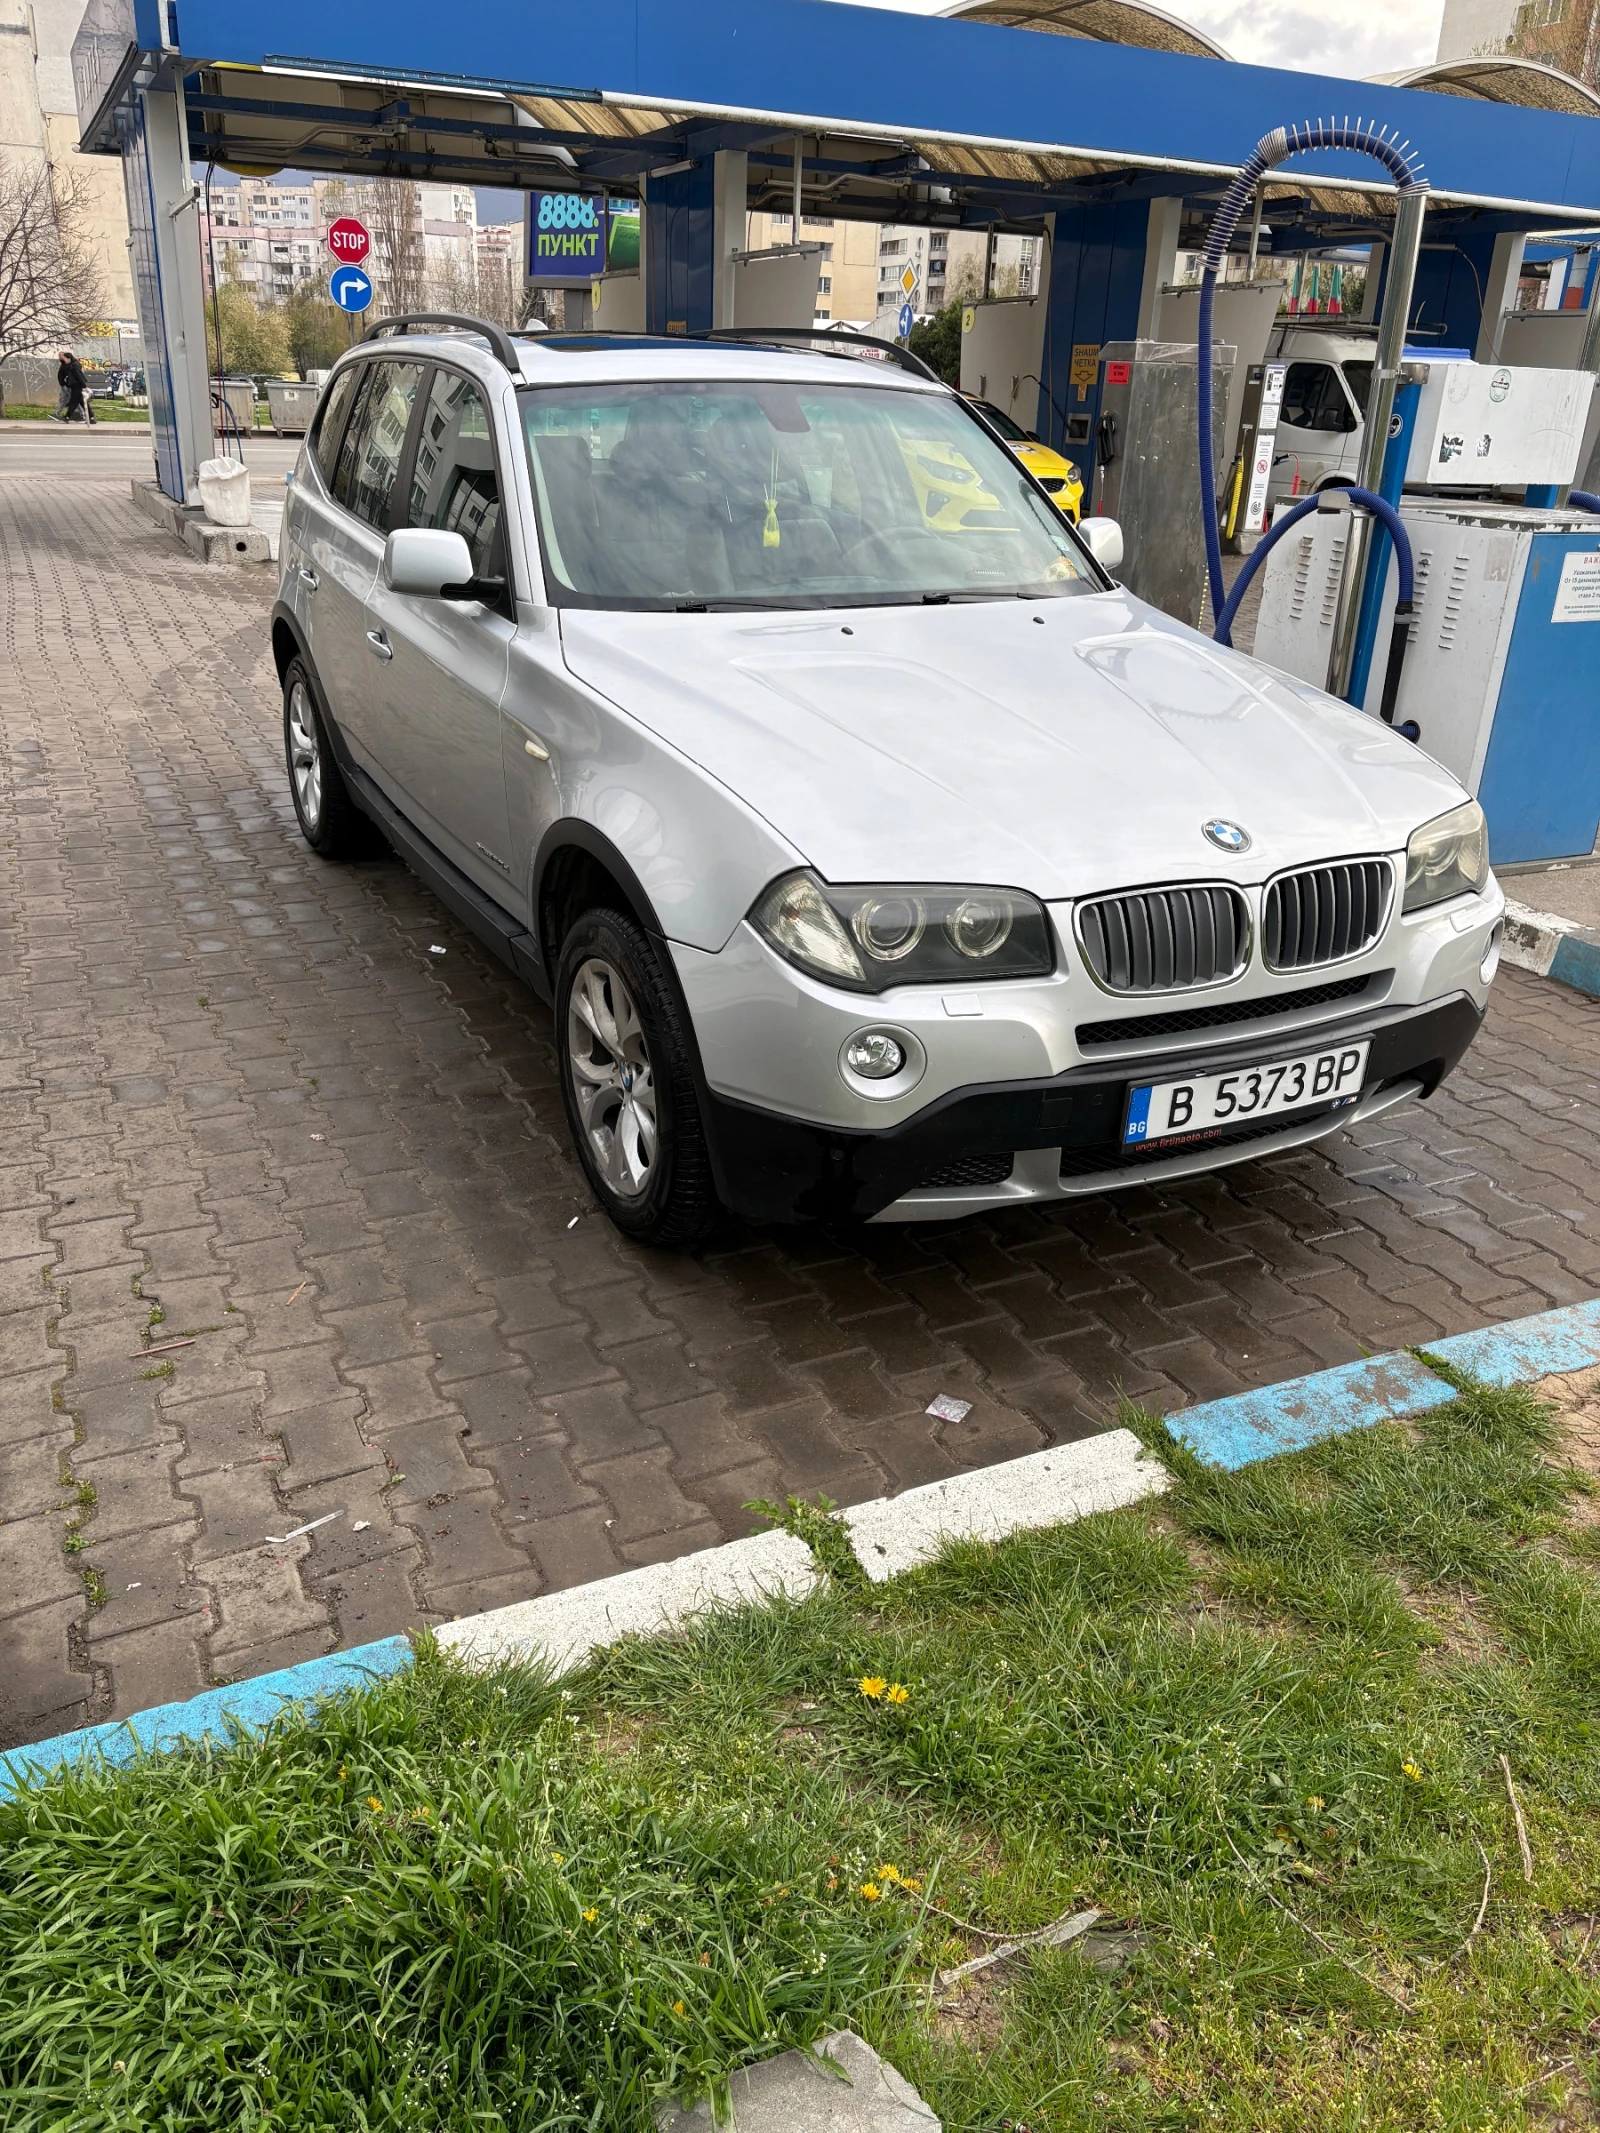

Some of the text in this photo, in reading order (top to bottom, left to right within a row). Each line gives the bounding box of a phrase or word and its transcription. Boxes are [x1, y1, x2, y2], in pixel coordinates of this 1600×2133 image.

[333, 231, 366, 250] STOP
[538, 233, 599, 257] ПУНКТ
[966, 314, 971, 326] 2
[1074, 347, 1099, 357] SHAUM
[1074, 358, 1096, 368] ЧЕТКА
[1583, 556, 1600, 564] ВАЖ
[1167, 1049, 1361, 1129] B 5373 BP
[1128, 1121, 1146, 1135] BG
